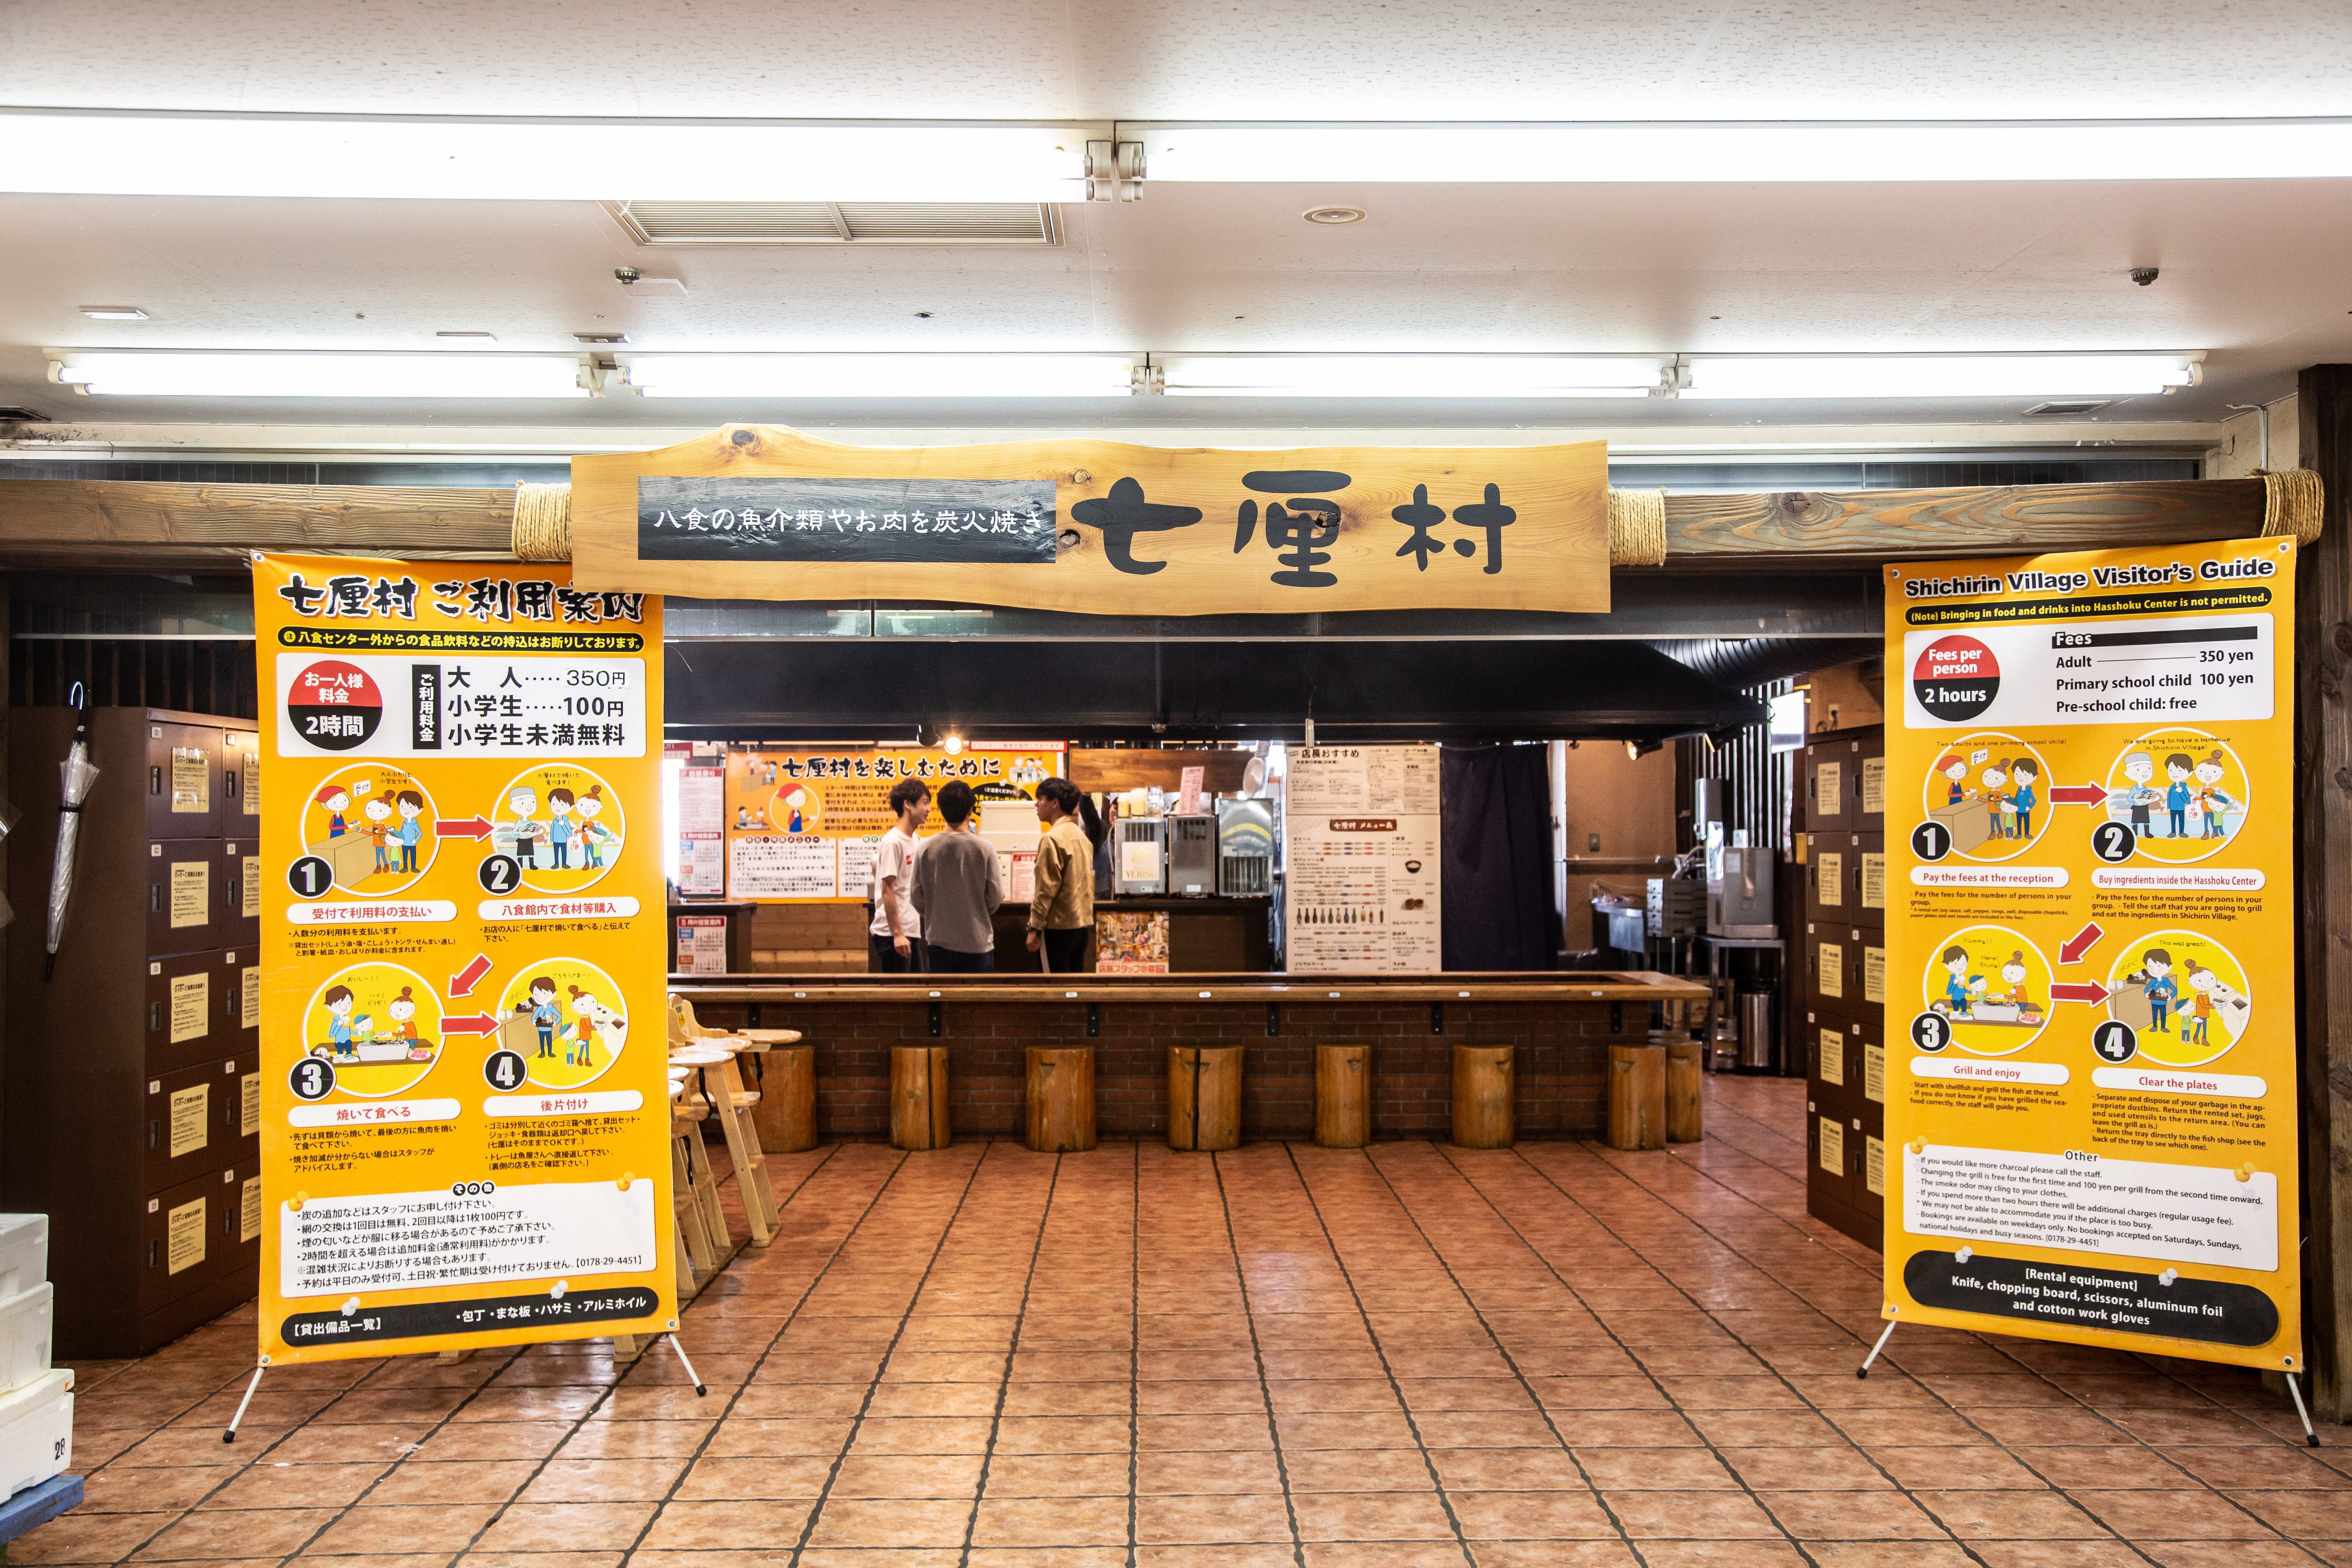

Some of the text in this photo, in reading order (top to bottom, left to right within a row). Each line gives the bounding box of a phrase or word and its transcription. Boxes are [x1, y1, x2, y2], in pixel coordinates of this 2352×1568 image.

[654, 508, 1041, 535] 八食の魚介類やお肉を炭火焼き
[1071, 470, 1516, 588] 七厘村
[1905, 559, 2273, 596] Shichirin Village Visitor's Guide
[280, 575, 644, 621] 七厘村 ご利用案内
[1912, 612, 1937, 622] (Note)
[1941, 610, 1980, 620] Bringing
[1994, 607, 2015, 616] food
[2018, 606, 2036, 615] and
[2039, 605, 2068, 614] drinks
[2094, 601, 2141, 611] Hasshoku
[2212, 593, 2268, 606] permitted.
[298, 631, 640, 649] 八食センター外からの食品飲料などの持込はお断りしております。
[2056, 633, 2092, 645] Fees
[1929, 649, 1982, 663] Fees per
[2056, 650, 2254, 668] Adult 350 yen
[566, 669, 626, 687] 350円
[1933, 663, 1977, 677] person
[305, 672, 363, 688] お一人様
[2056, 673, 2254, 692] Primary school child 100 yen
[319, 687, 349, 703] 料金
[1925, 687, 1986, 703] 2 hours
[419, 673, 435, 742] ご利用料金
[564, 697, 624, 717] 100円
[2056, 697, 2197, 713] Pre-school child: free
[306, 715, 363, 736] 2時間
[448, 723, 625, 746] 小学生未満無料
[782, 757, 1001, 778] 七厘村を楽しむために
[355, 783, 370, 795] 受付
[1923, 828, 1935, 856] 1
[2105, 827, 2123, 857] 2
[301, 862, 315, 892] 1
[491, 860, 509, 890] 2
[1924, 873, 1939, 883] Pay
[2010, 876, 2053, 884] reception
[2100, 875, 2112, 885] Buy
[2114, 876, 2154, 885] ingredients
[2180, 876, 2192, 884] the
[2195, 876, 2229, 885] Hasshoku
[2232, 877, 2256, 885] Center
[312, 906, 432, 920] 受付で利用料の支払い
[502, 902, 617, 916] 八食館内で食材等購入
[484, 935, 509, 943] 下さい。
[1922, 1018, 1939, 1047] 3
[2105, 1027, 2124, 1057] 4
[302, 1064, 322, 1095] 3
[496, 1056, 515, 1086] 4
[1954, 1066, 1972, 1074] Grill
[1995, 1070, 2020, 1079] enjoy
[2139, 1077, 2217, 1090] Clear the plates
[541, 1098, 589, 1111] 後片付け
[336, 1107, 411, 1121] 焼いて食べる
[294, 1141, 353, 1151] て食べて下さい。
[2066, 1151, 2097, 1161] Other
[294, 1162, 357, 1173] アドバイスします。
[454, 1182, 494, 1195] その他
[2026, 1268, 2137, 1291] [Rental equipment]
[1952, 1276, 2222, 1316] Knife, chopping board, scissors, aluminum foil
[2013, 1301, 2149, 1325] and cotton work gloves
[295, 1317, 381, 1337] 【貸出備品一覧】
[55, 1438, 66, 1461] 28
